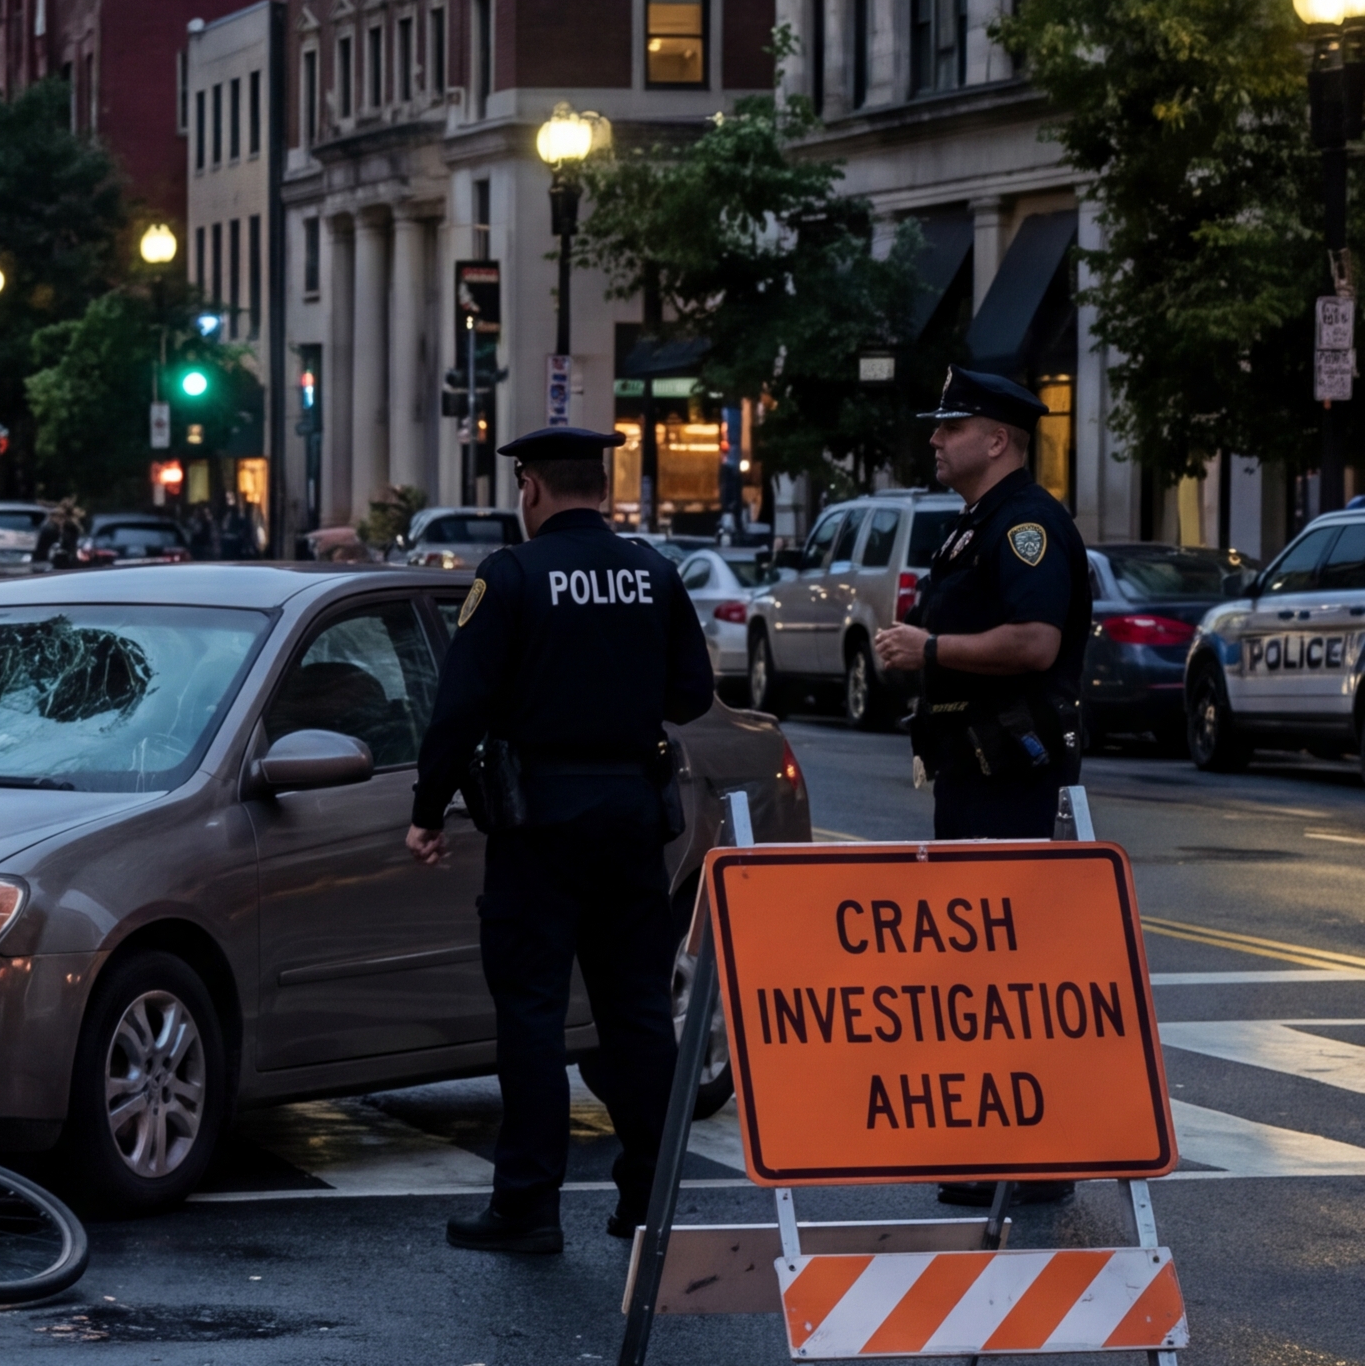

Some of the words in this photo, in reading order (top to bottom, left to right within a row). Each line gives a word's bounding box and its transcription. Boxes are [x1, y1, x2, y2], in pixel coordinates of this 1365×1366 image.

[549, 569, 653, 605] POLICE
[1246, 636, 1342, 671] POLICE
[836, 897, 1018, 954] CRASH
[757, 981, 1125, 1044] INVESTIGATION
[867, 1071, 1045, 1129] AHEAD
